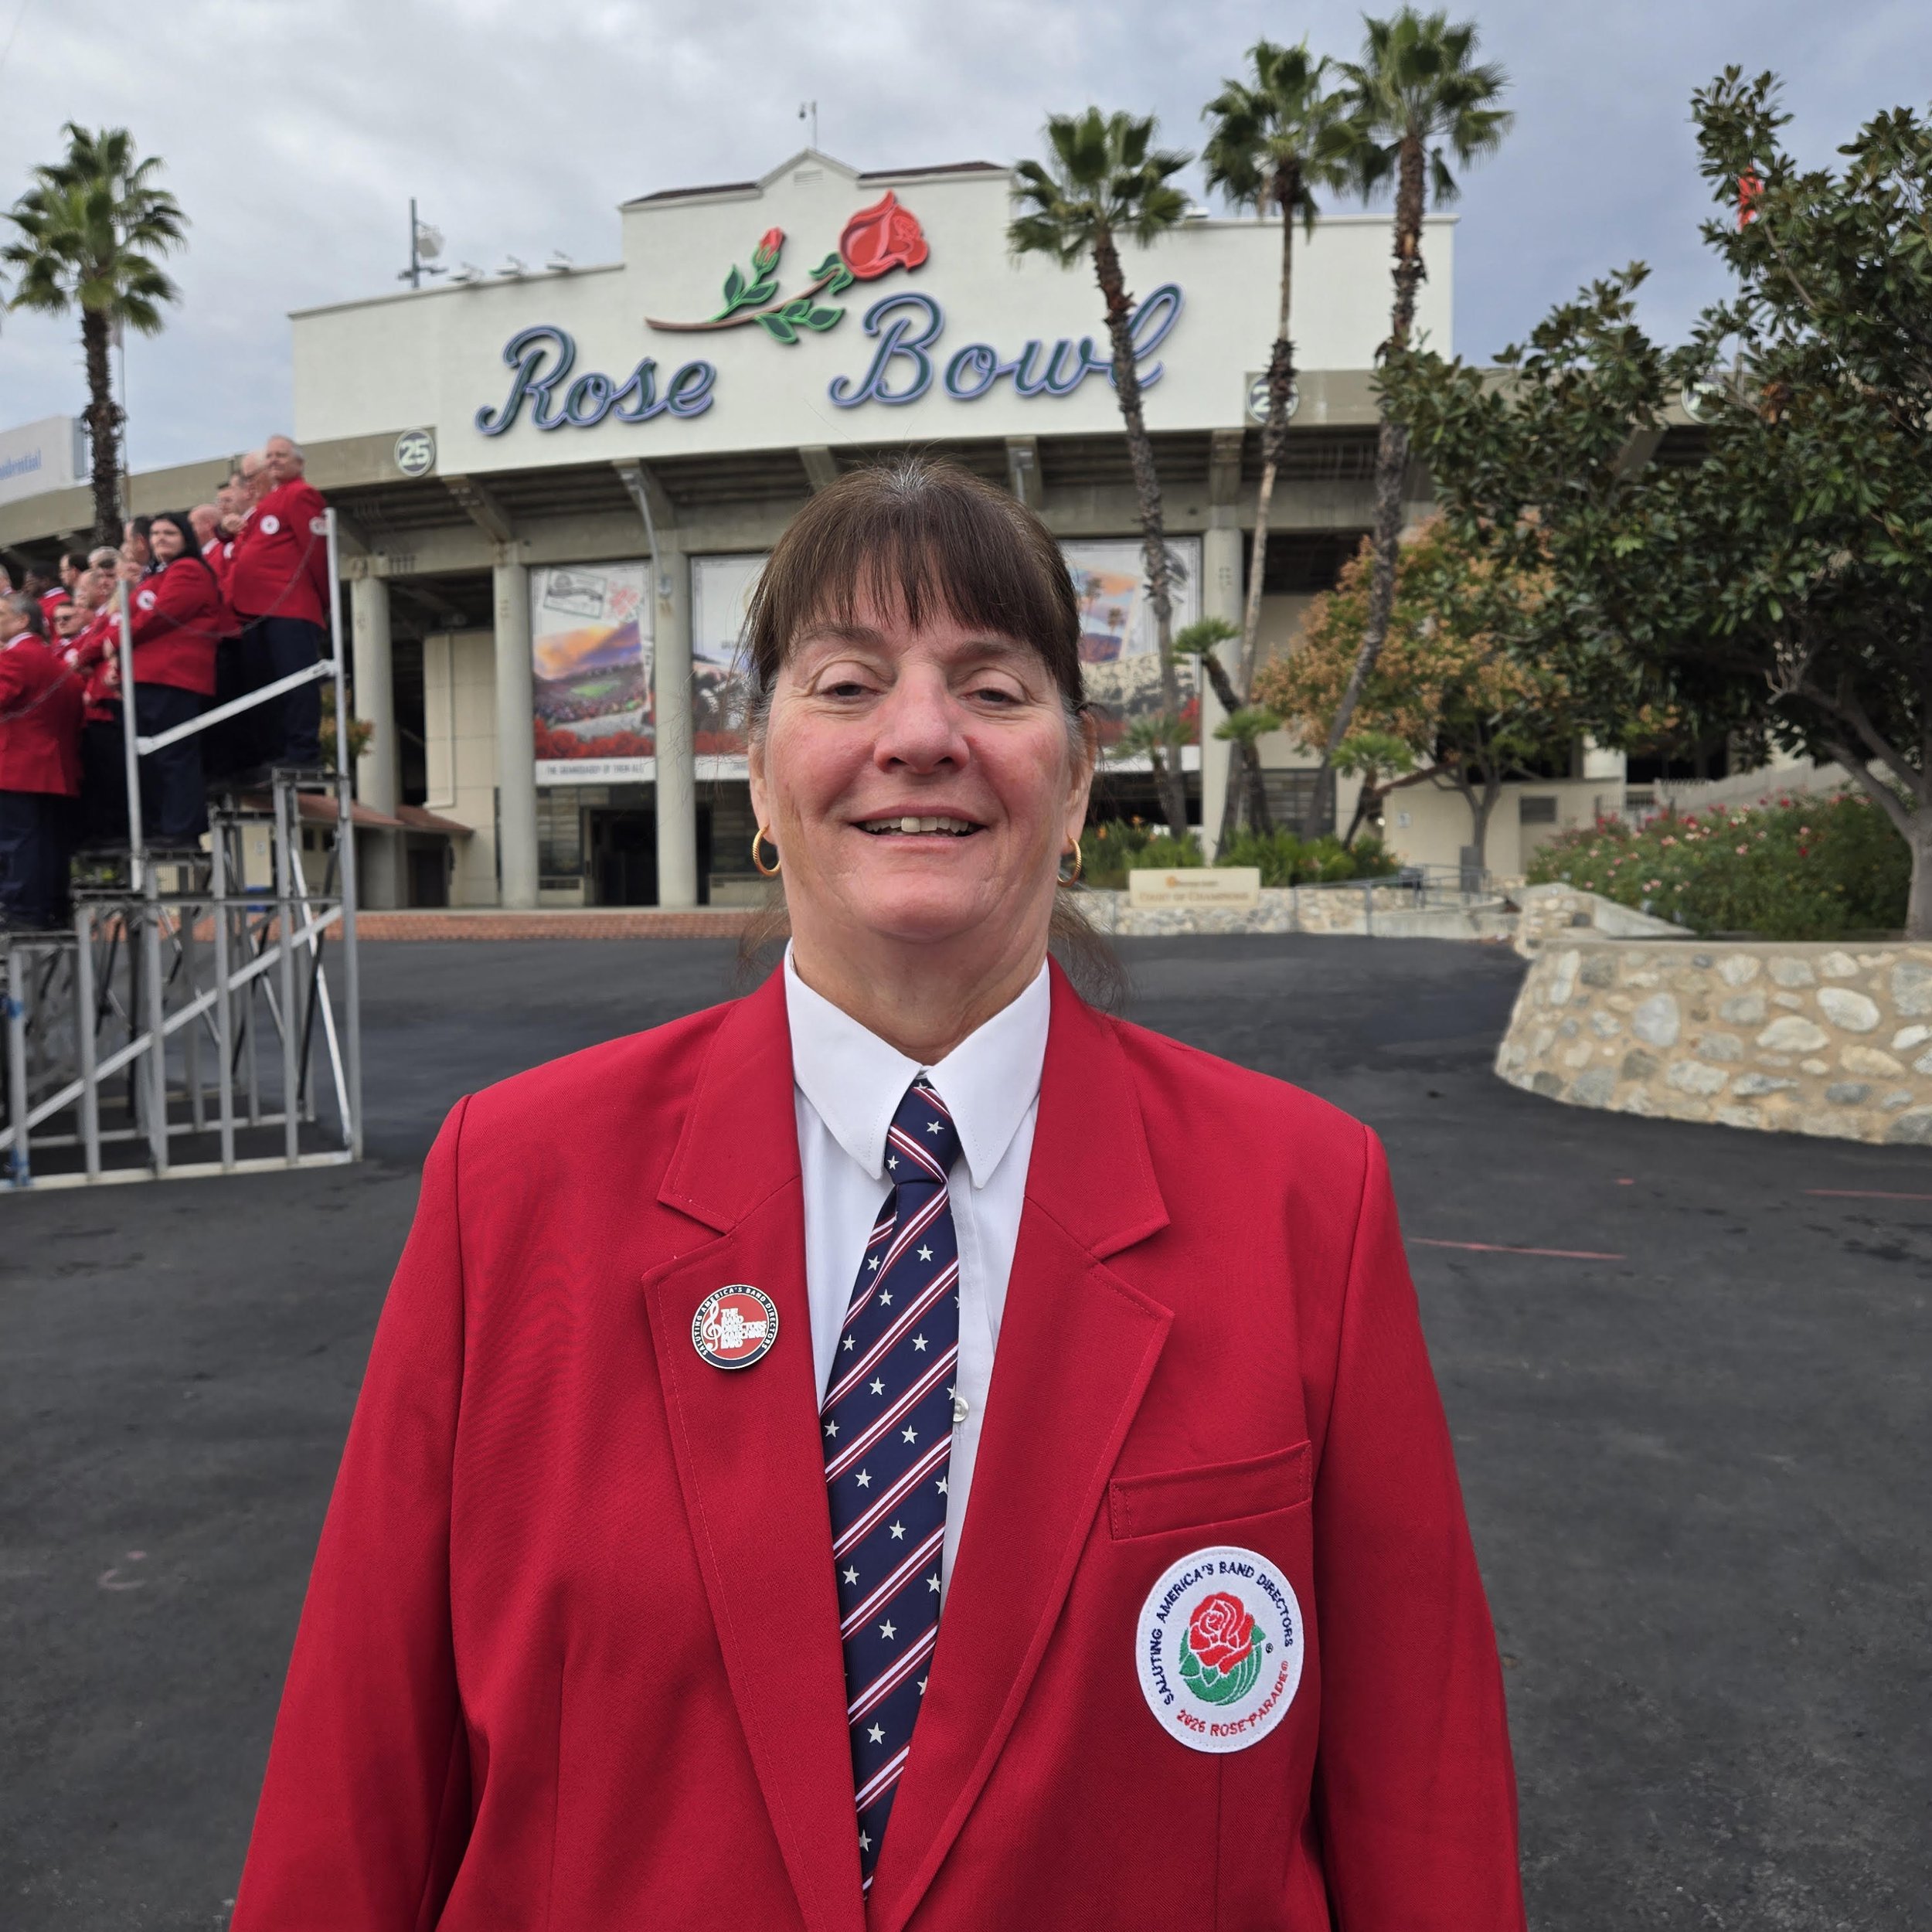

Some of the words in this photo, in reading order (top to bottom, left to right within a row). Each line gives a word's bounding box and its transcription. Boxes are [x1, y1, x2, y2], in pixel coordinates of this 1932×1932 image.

[474, 325, 716, 436] Rose
[827, 281, 1185, 409] Bowl
[400, 439, 430, 466] 25
[694, 1315, 708, 1355] SALUTING
[701, 1287, 743, 1313] AMERICA'S
[746, 1287, 766, 1302] BAND
[761, 1303, 776, 1349] DIRECTORS
[1156, 1563, 1214, 1624] AMERICA'S
[1219, 1561, 1255, 1579] BAND
[1256, 1573, 1294, 1647] DIRECTORS
[1150, 1628, 1174, 1706] SALUTING
[1176, 1709, 1206, 1733] 2026
[1210, 1719, 1247, 1737] ROSE
